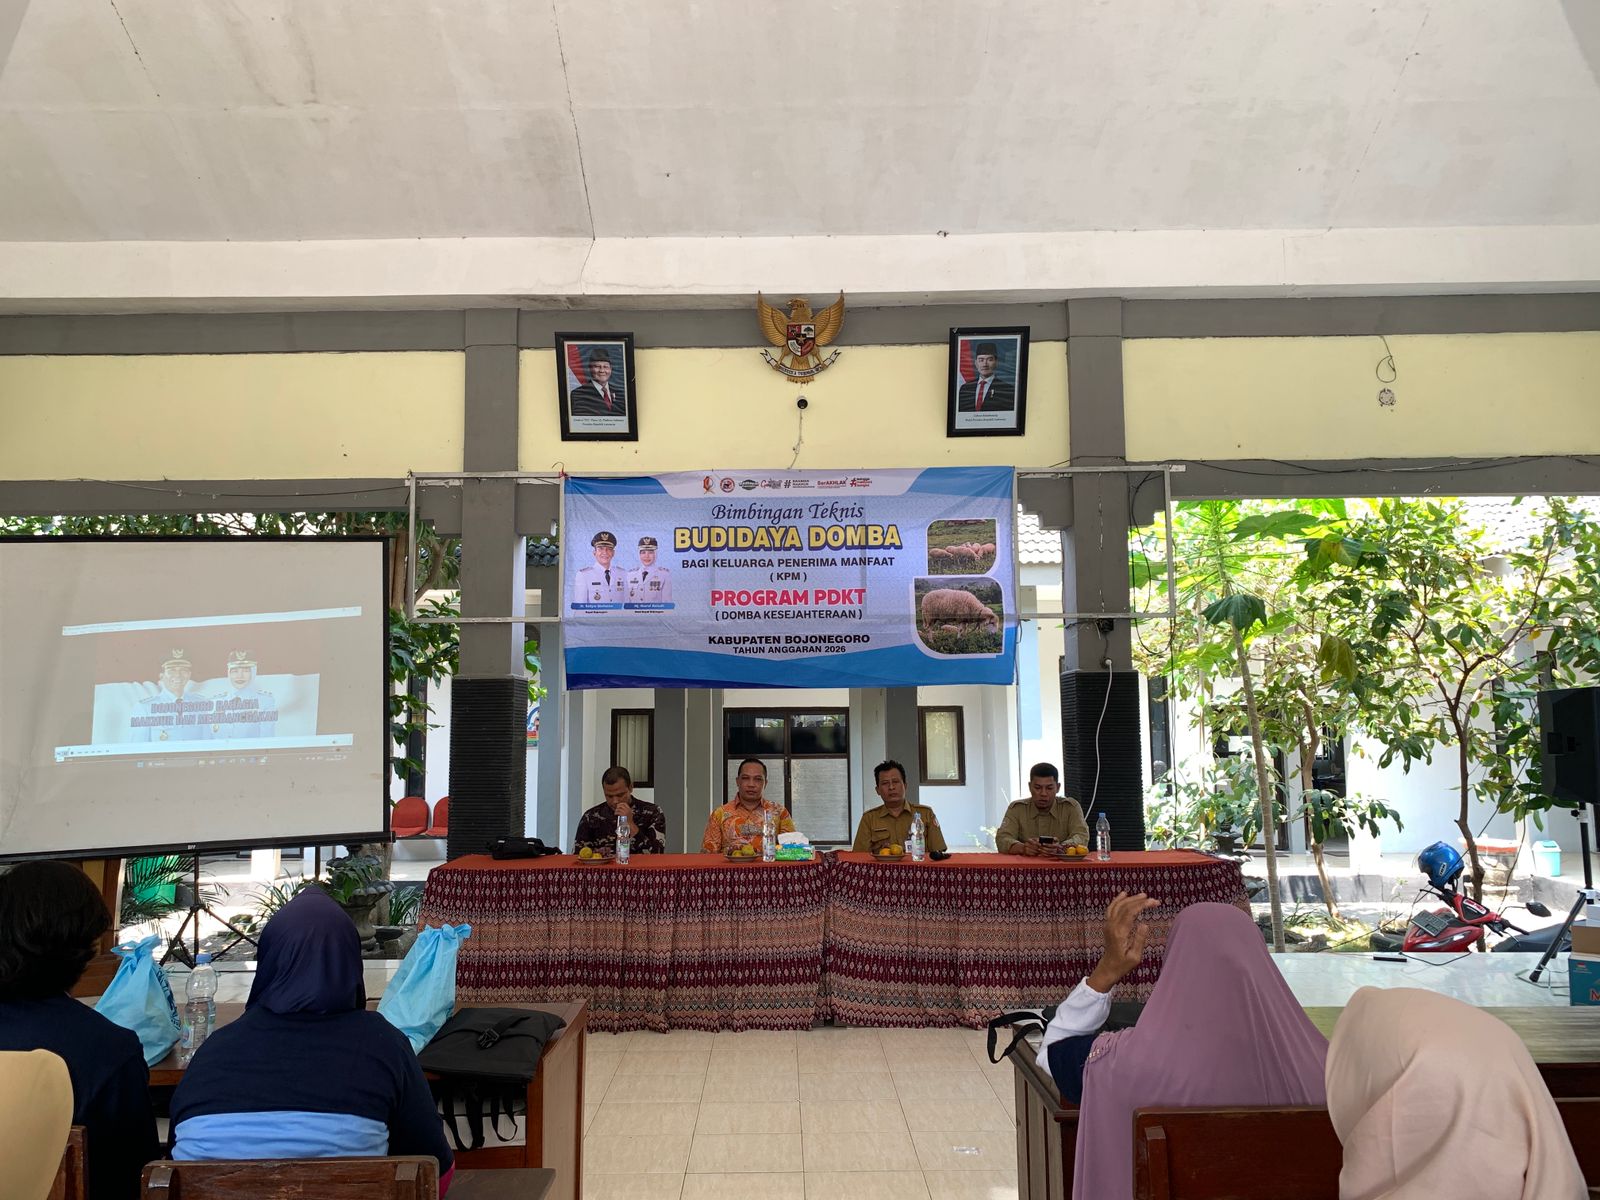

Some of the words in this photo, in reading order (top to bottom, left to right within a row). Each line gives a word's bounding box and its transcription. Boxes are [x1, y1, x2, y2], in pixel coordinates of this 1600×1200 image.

[711, 502, 803, 525] Bimbingan
[808, 501, 864, 522] Teknis
[674, 525, 803, 552] BUDIDAYA
[808, 524, 903, 551] DOMBA
[681, 559, 709, 568] BAGI
[712, 558, 774, 568] KELUARGA
[777, 558, 837, 568] PENERIMA
[840, 557, 895, 567] MANFAAT
[710, 589, 809, 606] PROGRAM
[814, 588, 867, 606] PDKT
[708, 635, 781, 645] KABUPATEN
[785, 634, 871, 644] BOJONEGORO
[733, 646, 766, 654] TAHUN
[768, 646, 822, 654] ANGGARAN
[825, 645, 846, 653] 2026
